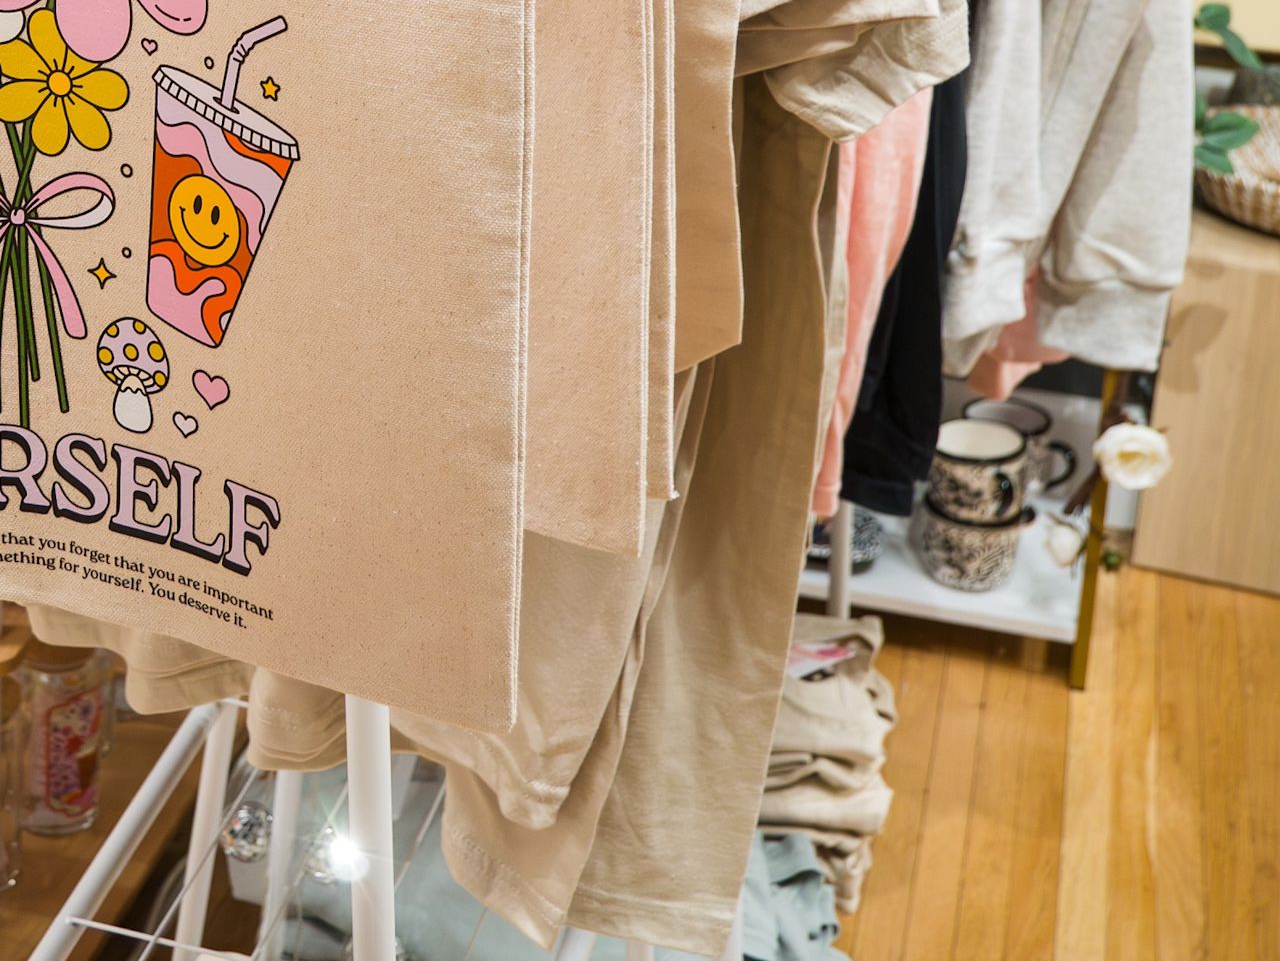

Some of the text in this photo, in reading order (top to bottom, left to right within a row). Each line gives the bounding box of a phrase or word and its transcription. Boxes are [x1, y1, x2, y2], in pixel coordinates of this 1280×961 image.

[1, 531, 35, 547] that
[38, 537, 66, 551] you
[69, 540, 111, 565] forget
[113, 555, 145, 574] that
[148, 566, 176, 584] you
[177, 575, 201, 591] are
[203, 580, 274, 621] important
[58, 556, 80, 574] for
[81, 566, 145, 593] yourself.
[148, 581, 176, 602] You
[178, 591, 231, 623] deserve
[233, 612, 248, 629] it.
